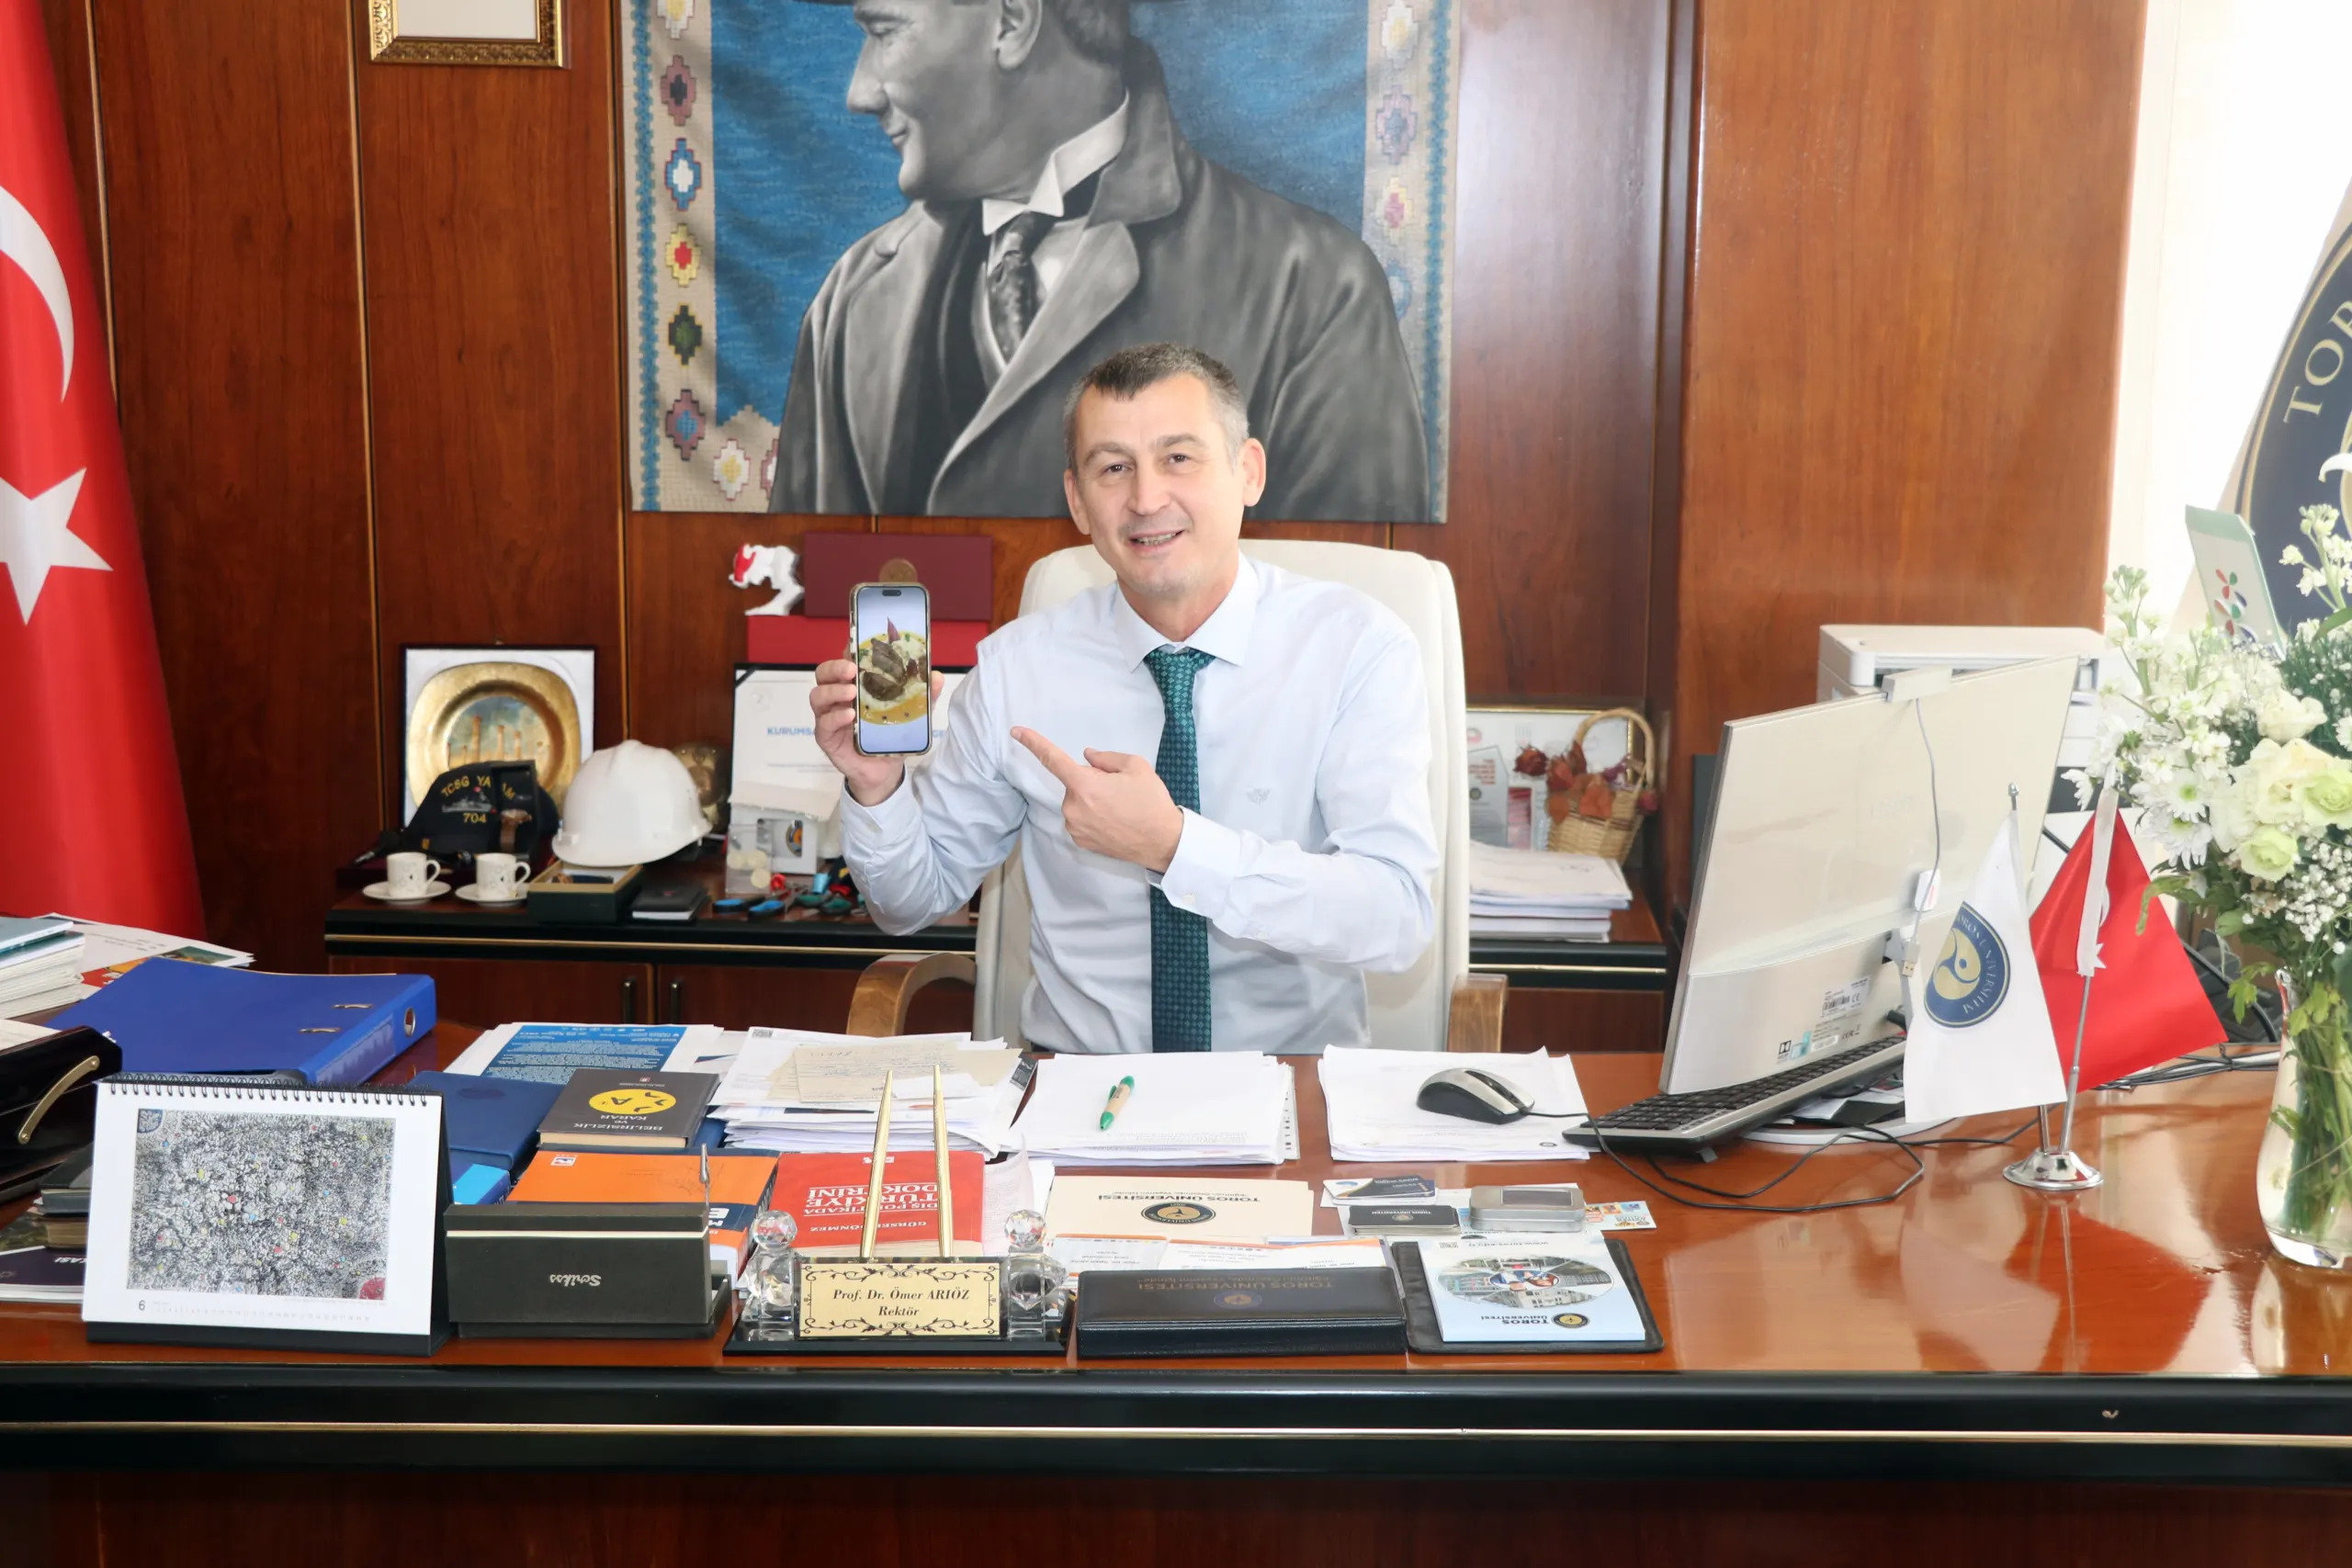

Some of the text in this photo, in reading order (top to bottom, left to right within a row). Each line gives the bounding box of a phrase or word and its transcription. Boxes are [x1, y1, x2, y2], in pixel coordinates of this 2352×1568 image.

[767, 727, 815, 736] KURUMS
[463, 812, 487, 823] 704
[808, 1184, 937, 1200] DOKRİNİ
[549, 1274, 602, 1287] Scrikss
[832, 1286, 970, 1303] Prof. Dr. Ömer ARIÖZ
[138, 1300, 146, 1311] 6
[878, 1305, 920, 1316] Rektör
